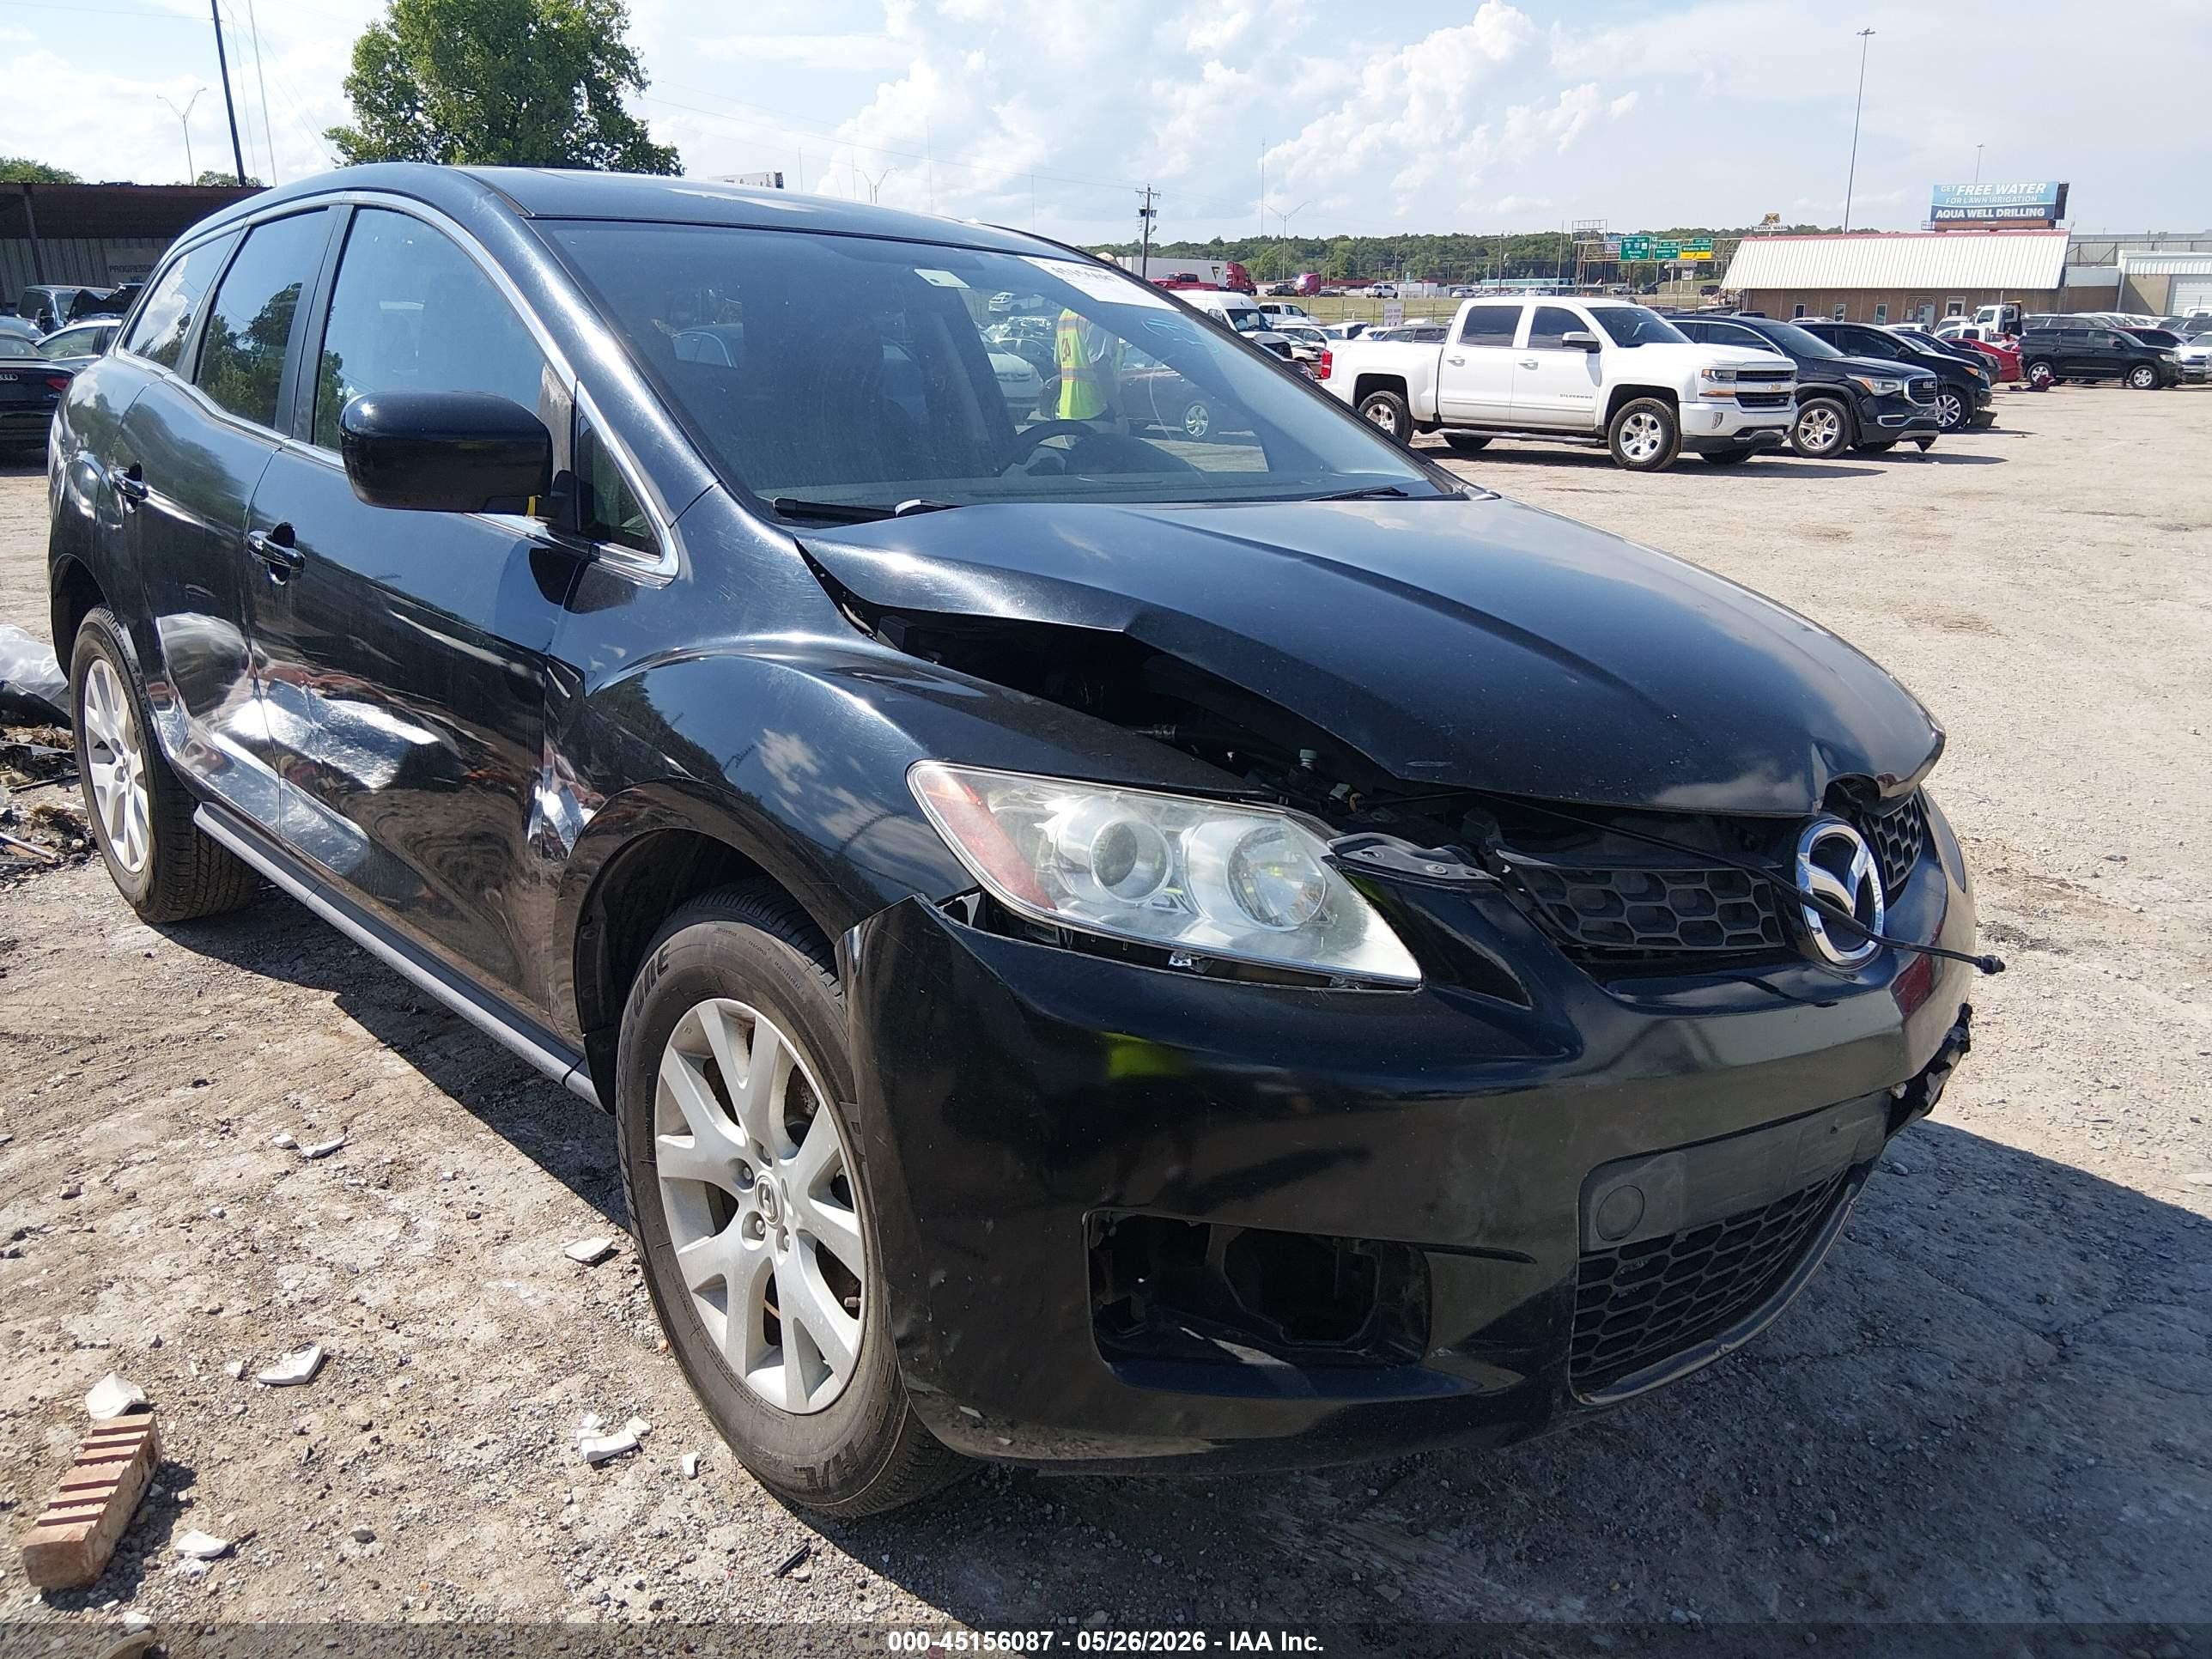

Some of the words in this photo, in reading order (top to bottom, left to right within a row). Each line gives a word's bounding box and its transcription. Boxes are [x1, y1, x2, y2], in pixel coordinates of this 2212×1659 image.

[1956, 184, 1993, 196] FREE
[1996, 183, 2047, 195] WATER
[1936, 209, 1965, 219] AQUA
[1966, 209, 1995, 218] WELL
[1996, 208, 2045, 218] DRILLING
